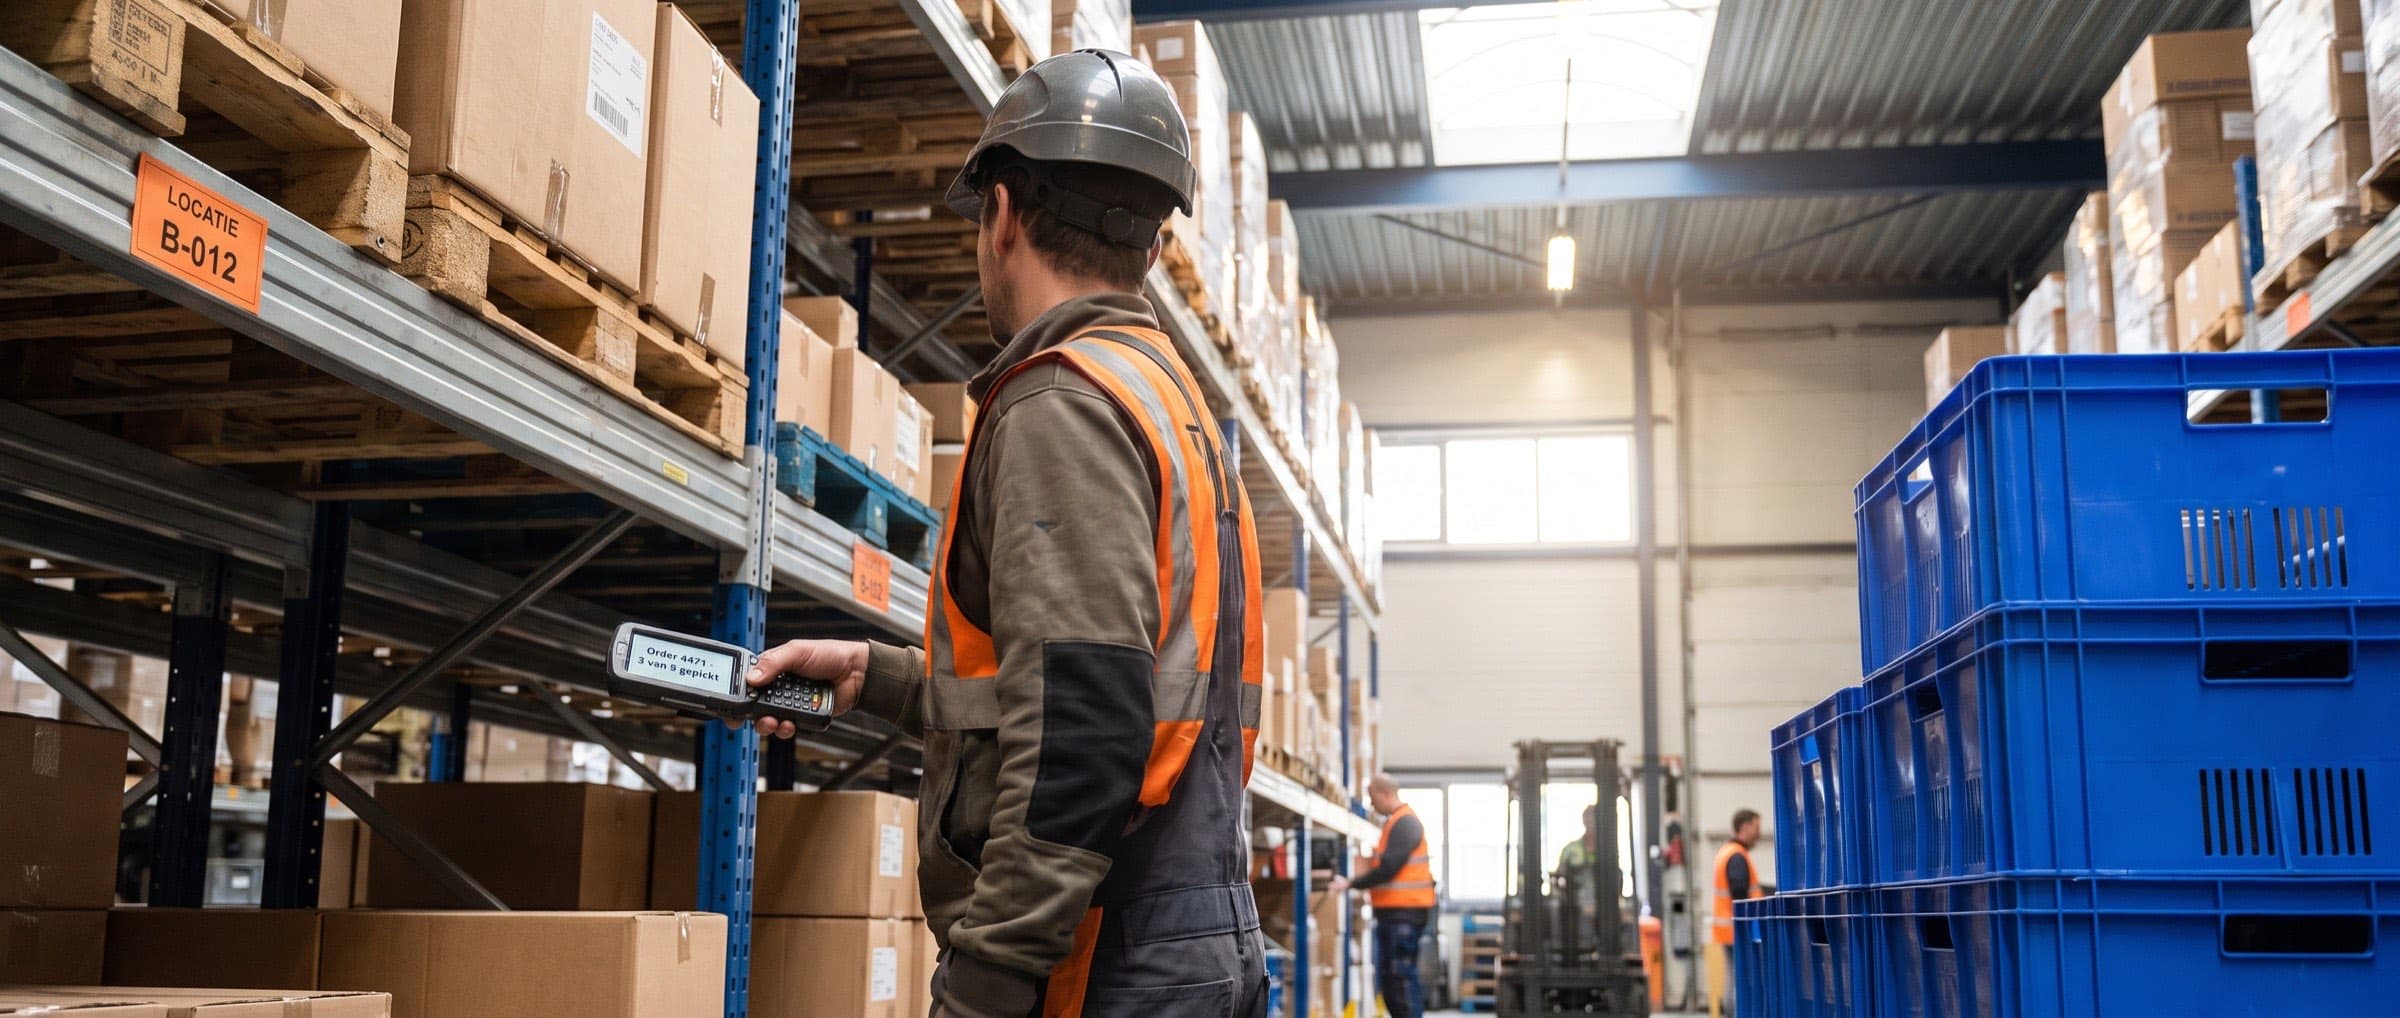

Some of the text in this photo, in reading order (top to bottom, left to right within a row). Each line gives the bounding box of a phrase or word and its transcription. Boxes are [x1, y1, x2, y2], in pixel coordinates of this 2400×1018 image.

[167, 185, 239, 238] LOCATIE
[160, 218, 237, 284] B-012
[637, 656, 645, 664] 3
[647, 660, 667, 669] van
[679, 666, 719, 681] gepickt
[647, 647, 678, 660] Order
[680, 655, 706, 667] 4471
